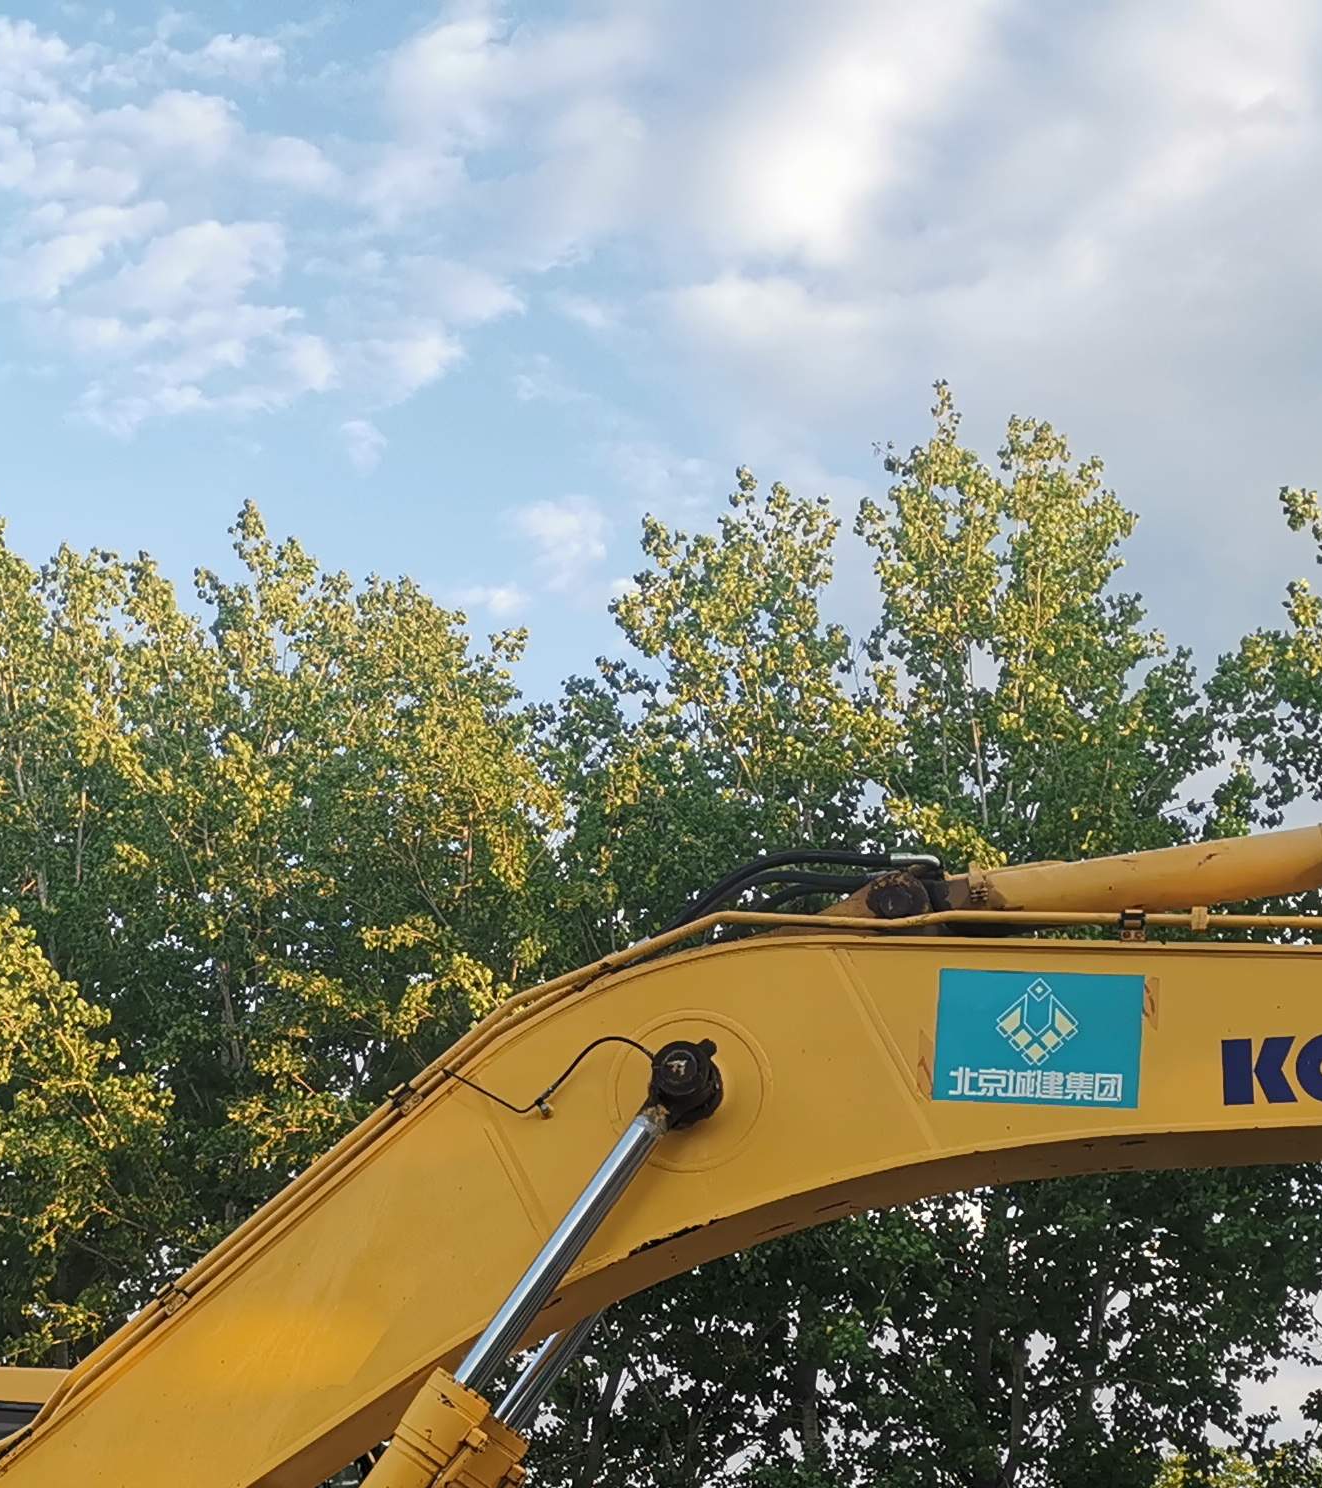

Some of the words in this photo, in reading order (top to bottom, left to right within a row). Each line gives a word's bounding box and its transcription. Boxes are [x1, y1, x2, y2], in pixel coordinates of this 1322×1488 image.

[948, 1066, 1123, 1102] 北京城建集团
